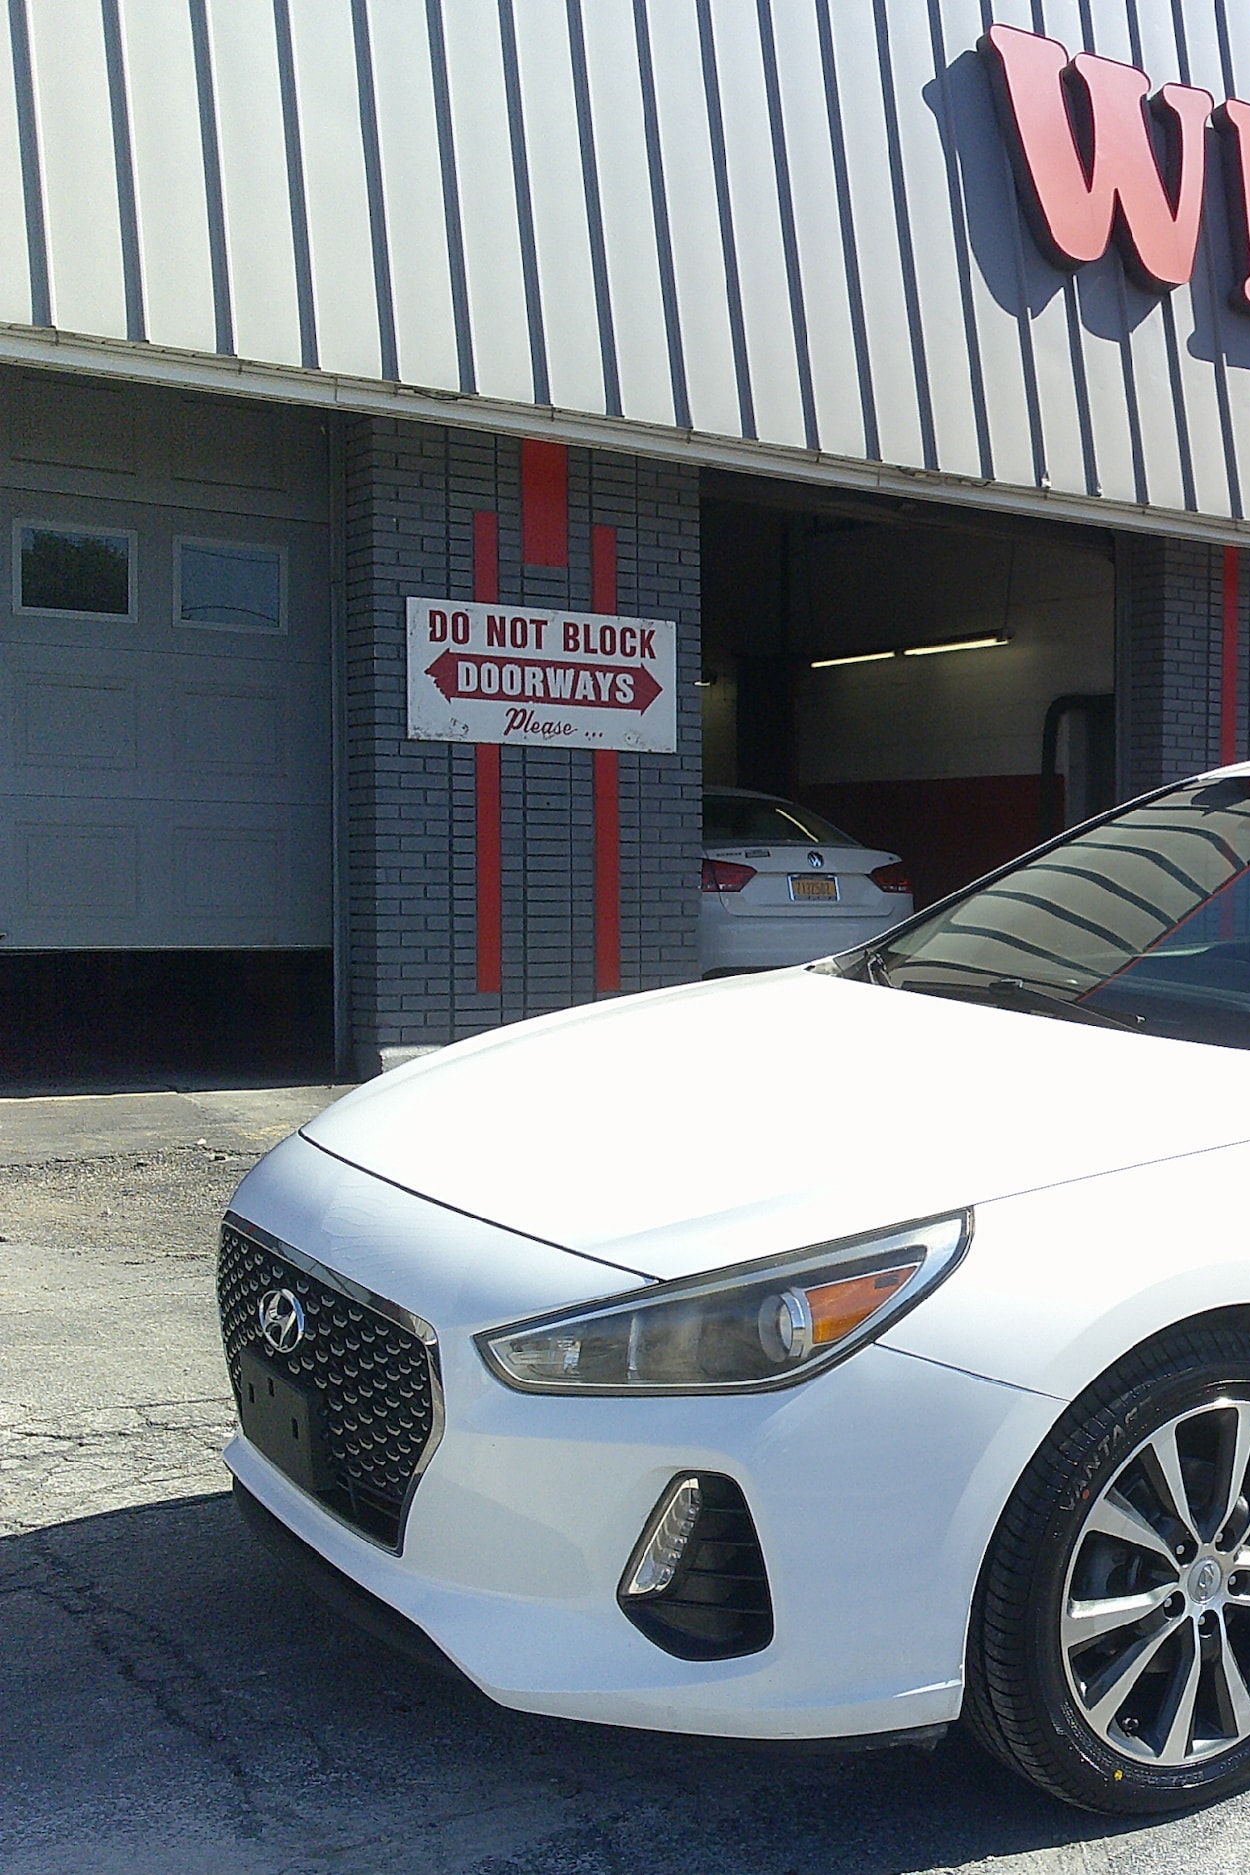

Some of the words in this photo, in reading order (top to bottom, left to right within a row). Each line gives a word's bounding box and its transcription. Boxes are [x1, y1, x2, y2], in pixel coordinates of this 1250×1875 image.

[428, 609, 471, 645] DO
[486, 614, 549, 650] NOT
[562, 621, 657, 660] BLOCK
[456, 660, 636, 704] DOORWAYS
[503, 707, 578, 736] Please
